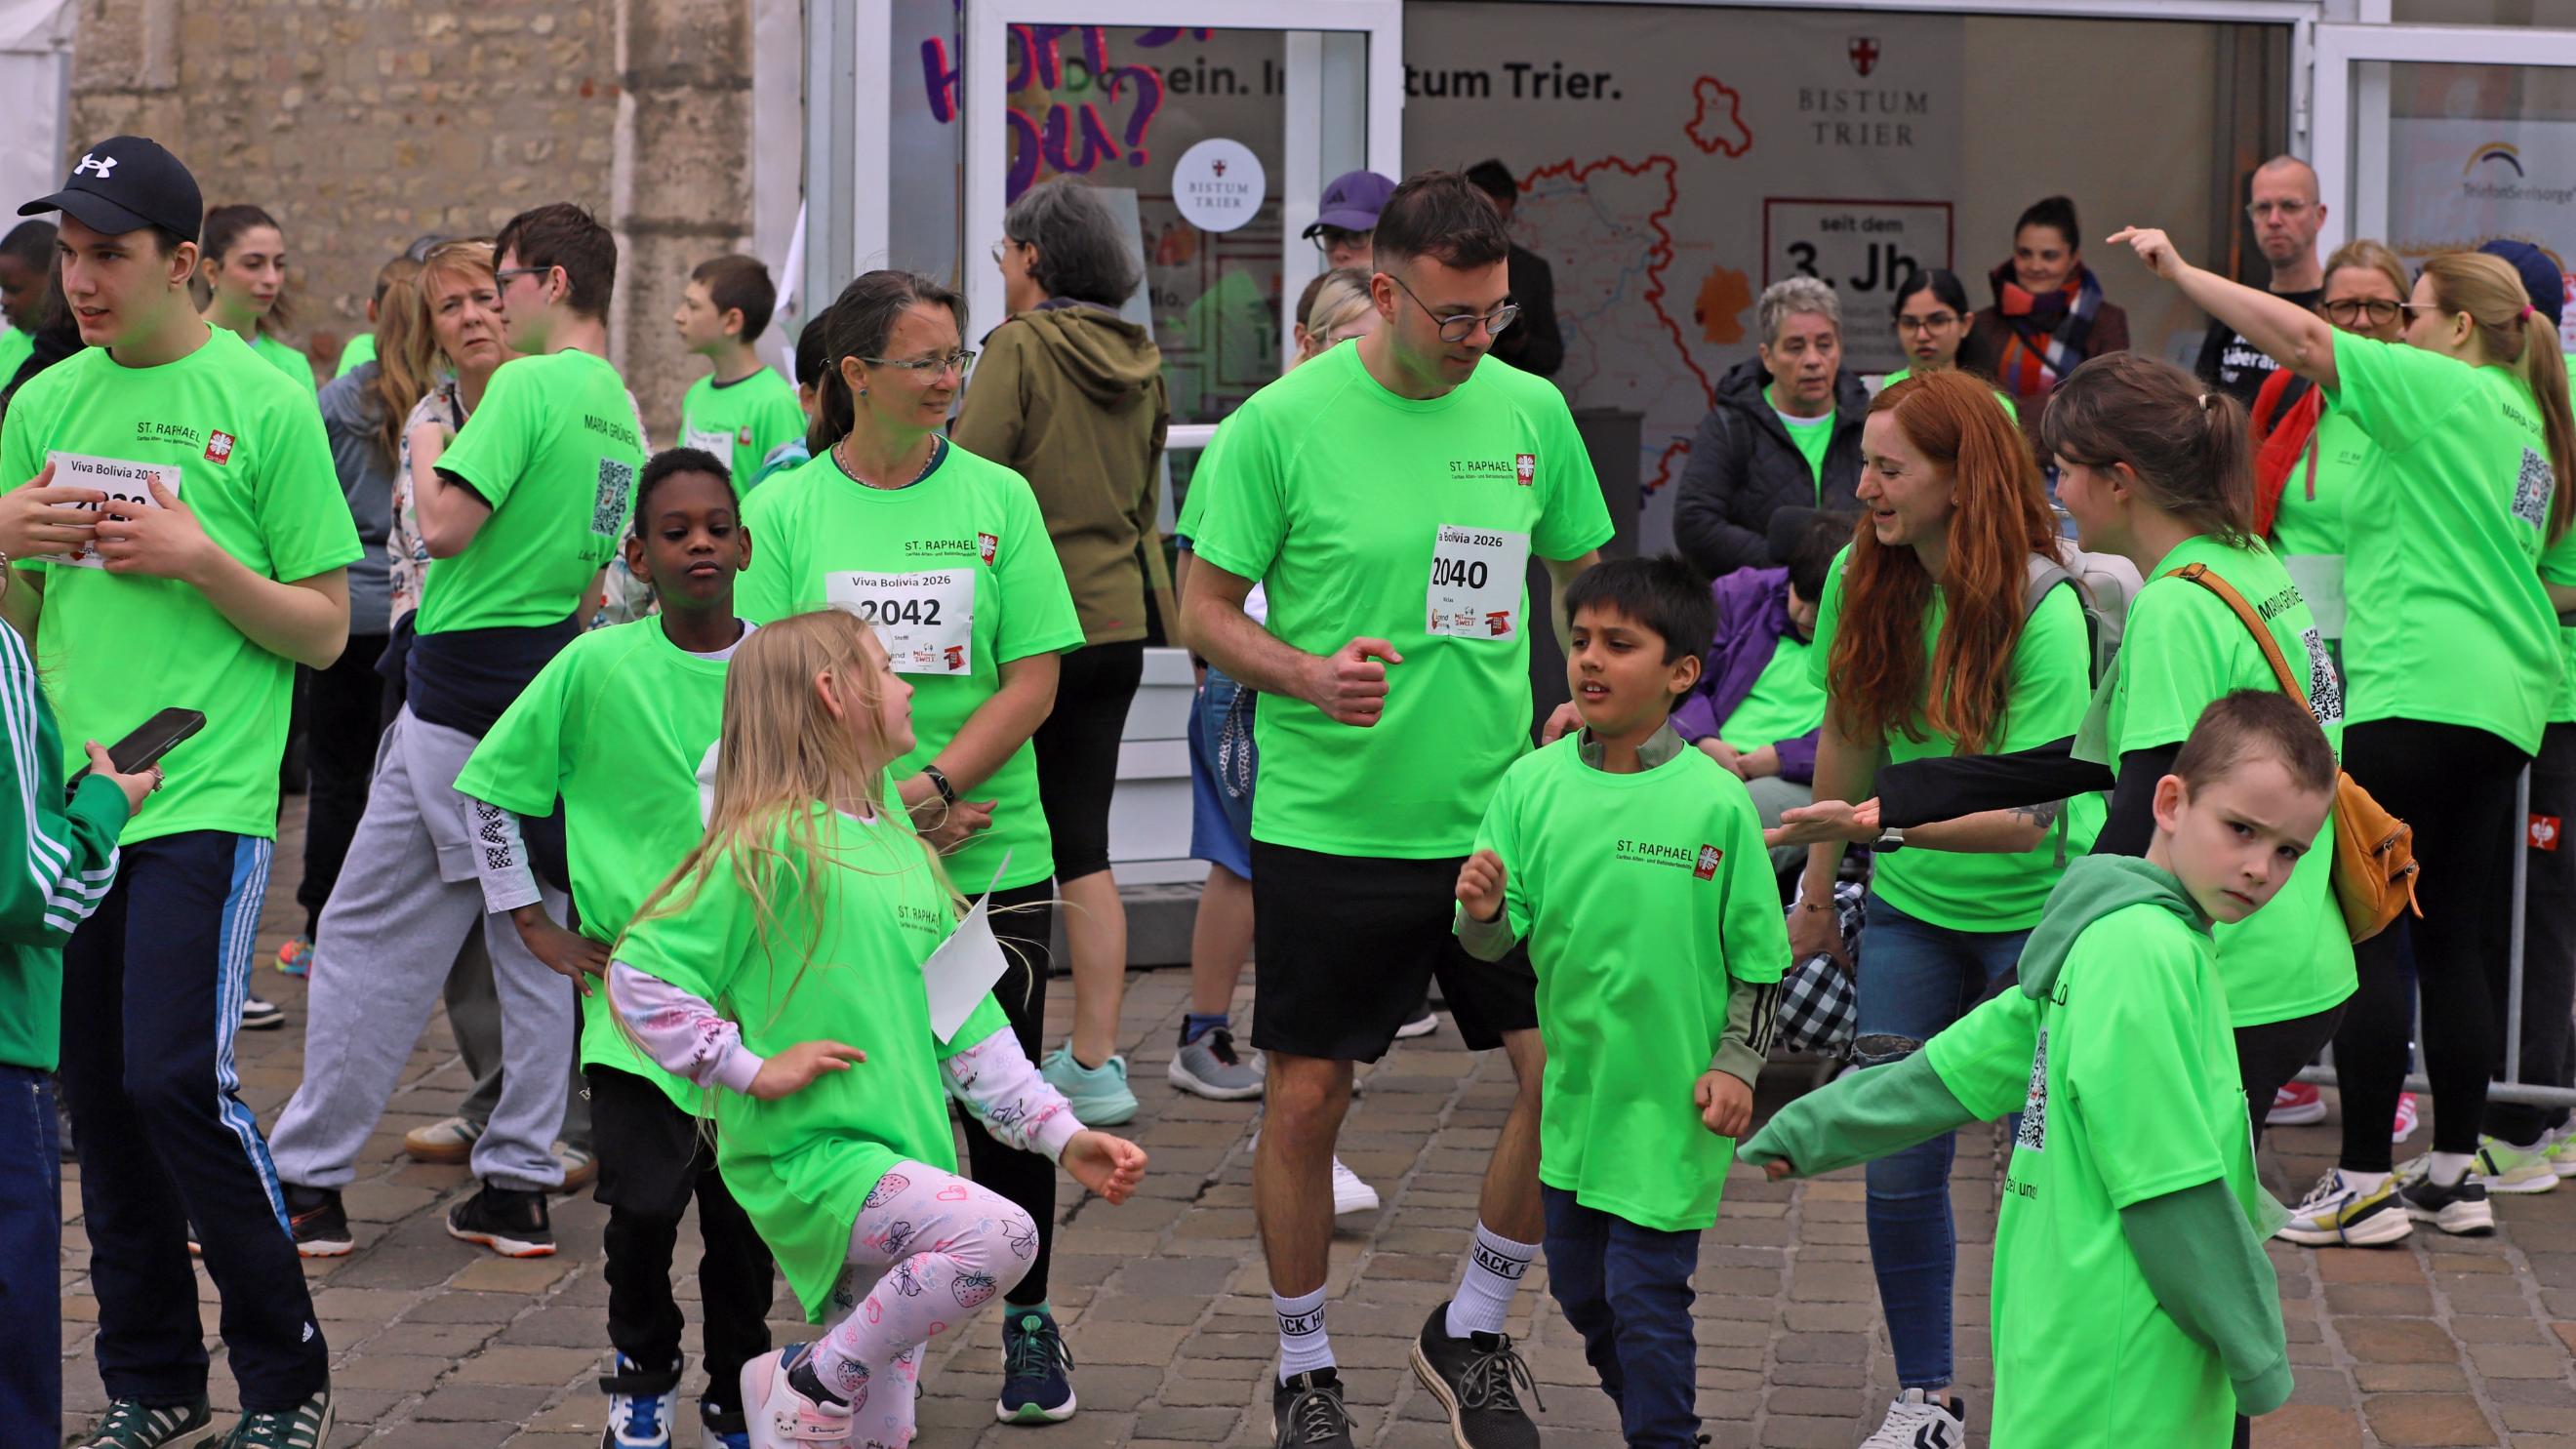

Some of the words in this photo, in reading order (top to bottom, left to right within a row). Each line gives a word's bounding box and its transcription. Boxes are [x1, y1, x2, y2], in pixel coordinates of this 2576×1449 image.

[1504, 61, 1622, 100] Trier.
[1798, 88, 1929, 115] BISTUM
[1812, 120, 1914, 147] TRIER
[1188, 182, 1249, 194] BISTUM
[1194, 196, 1242, 208] TRIER
[1821, 216, 1857, 232] seit
[1861, 216, 1904, 232] dem
[137, 422, 152, 433] ST.
[156, 423, 200, 444] RAPHAEL
[71, 461, 95, 474] Viva
[96, 463, 133, 479] Bolivia
[135, 468, 162, 482] 206
[1449, 461, 1465, 472] ST.
[1468, 461, 1513, 472] RAPHAEL
[905, 541, 922, 551] ST.
[925, 540, 977, 550] RAPHAEL
[1474, 535, 1503, 547] 2026
[852, 576, 877, 587] Viva
[880, 576, 919, 588] Bolivia
[922, 575, 951, 586] 2026
[1432, 556, 1488, 589] 2040
[861, 598, 942, 626] 2042
[1617, 839, 1634, 853] ST.
[1638, 842, 1694, 862] RAPHAEL
[1473, 1240, 1515, 1276] HACK
